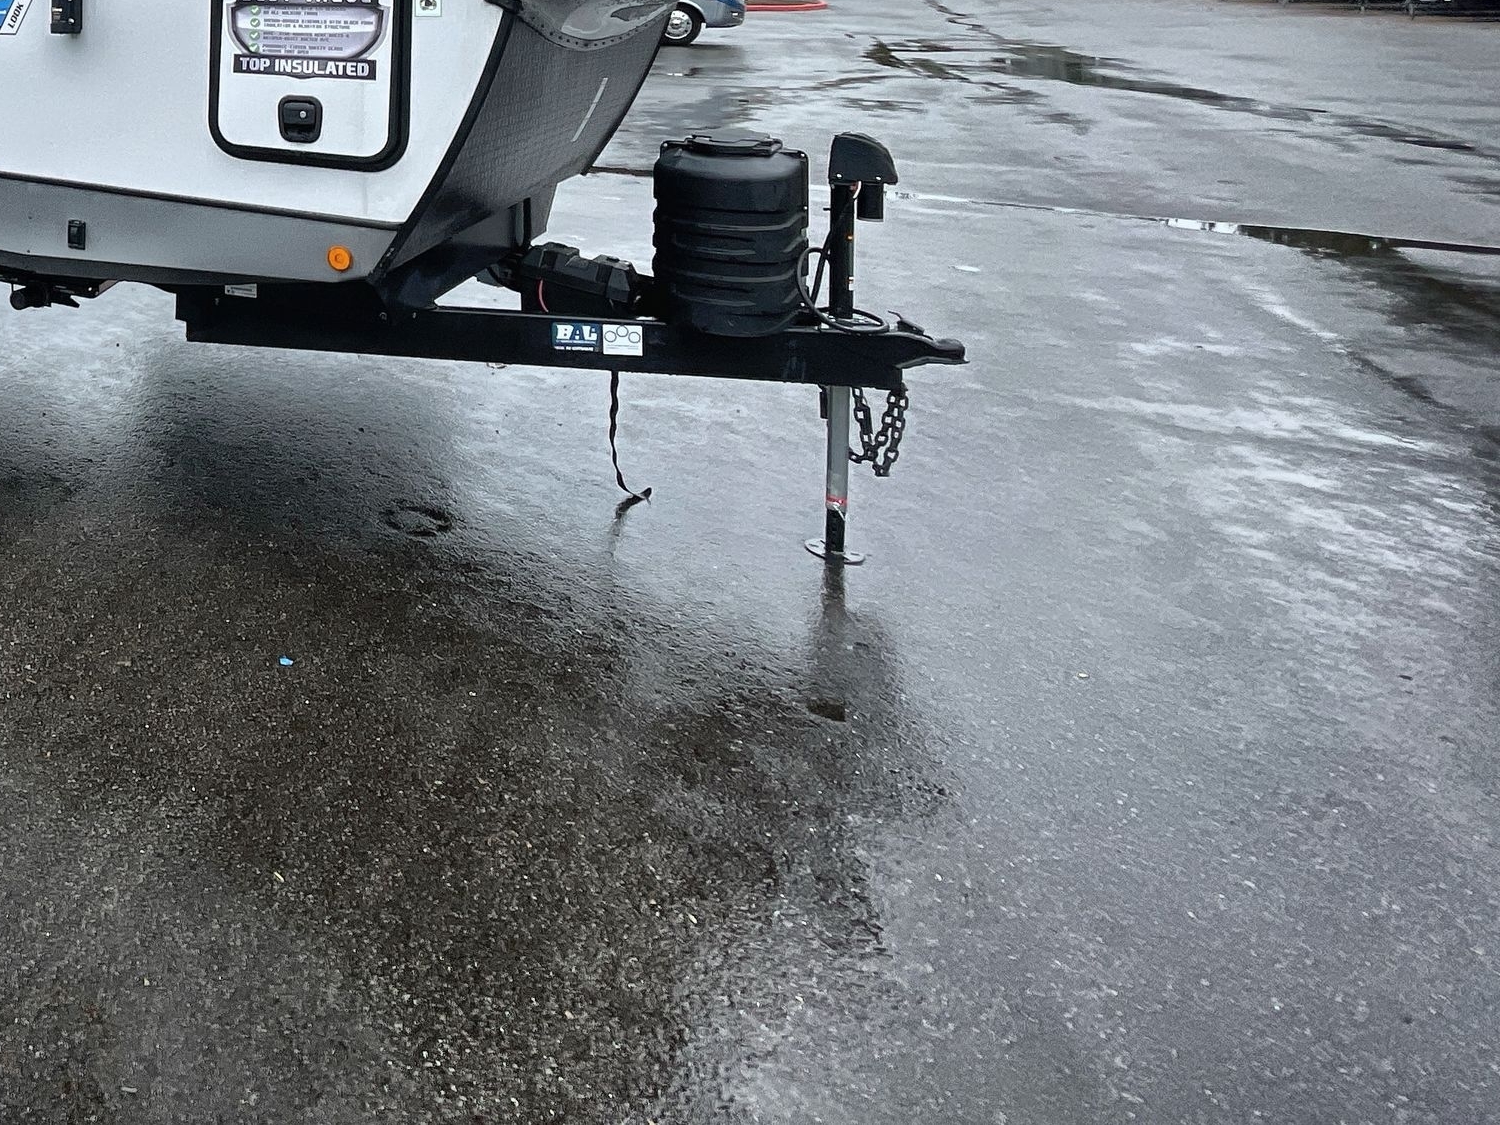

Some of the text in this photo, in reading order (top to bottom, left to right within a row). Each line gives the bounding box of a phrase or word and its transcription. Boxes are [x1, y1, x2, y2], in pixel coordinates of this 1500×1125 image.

[7, 3, 24, 29] LOOK
[240, 57, 370, 76] TOP INSULATED
